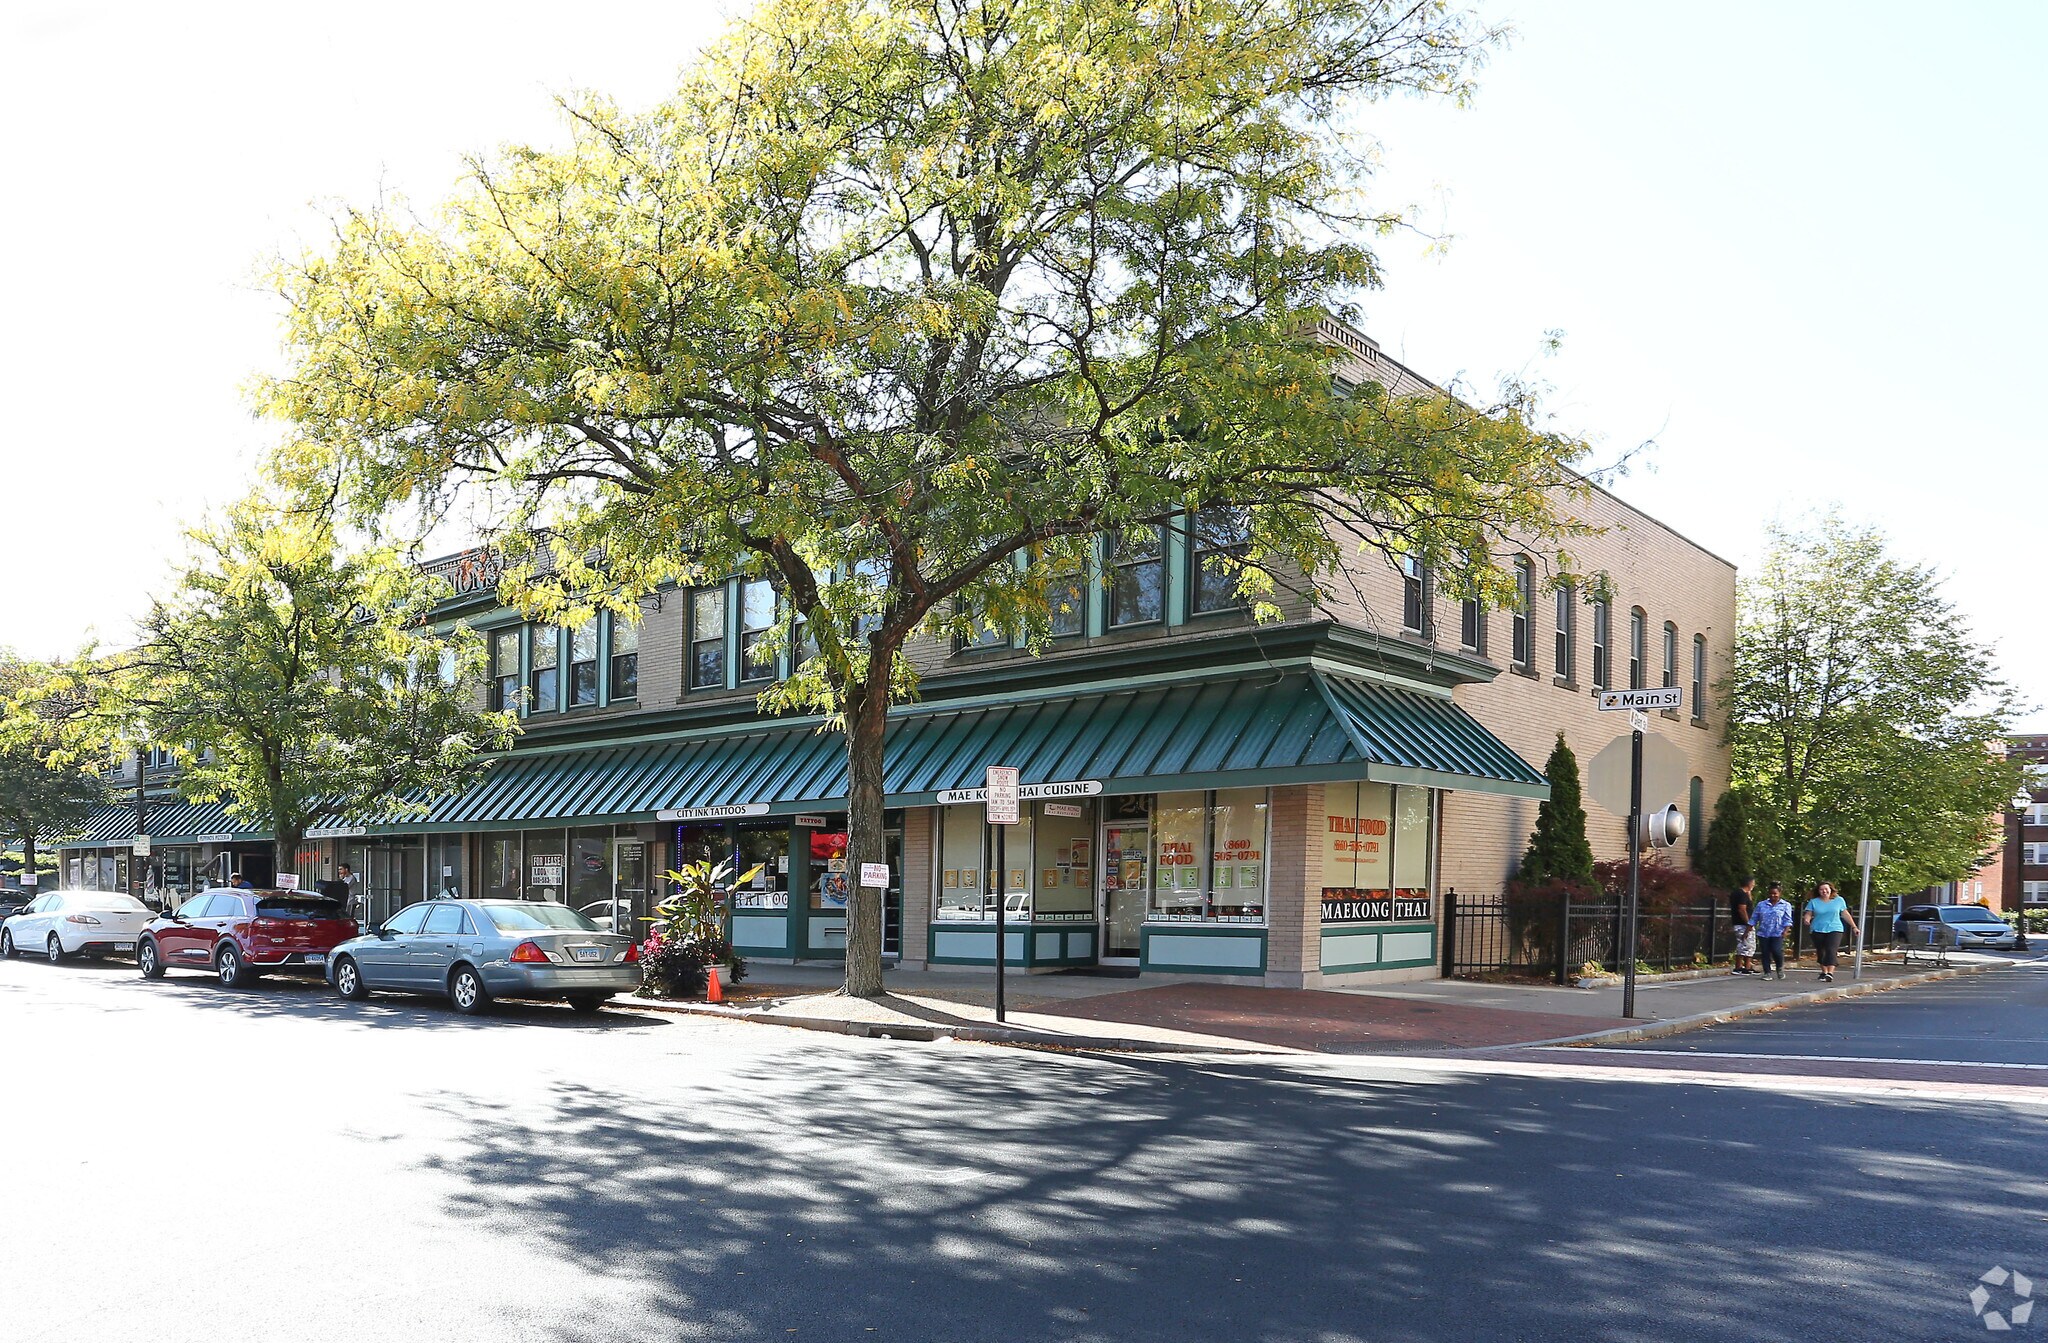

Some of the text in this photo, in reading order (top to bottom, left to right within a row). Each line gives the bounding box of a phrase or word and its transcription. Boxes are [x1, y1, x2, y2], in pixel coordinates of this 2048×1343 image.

[1622, 693, 1678, 706] Main St
[947, 791, 971, 801] MAE
[1043, 783, 1090, 795] CUISINE
[676, 805, 746, 818] CITY INK TATTOOS
[799, 817, 822, 825] TATTOO
[1327, 815, 1387, 836] THAI FOOD
[1160, 842, 1193, 854] THAI
[1223, 839, 1251, 850] (860)
[533, 856, 561, 866] FOR LEASE
[1159, 854, 1195, 865] FOOD
[1213, 851, 1260, 861] 505-0791
[873, 864, 881, 872] NO
[863, 871, 887, 880] PARKING
[1321, 901, 1428, 920] MAEKONG THAI
